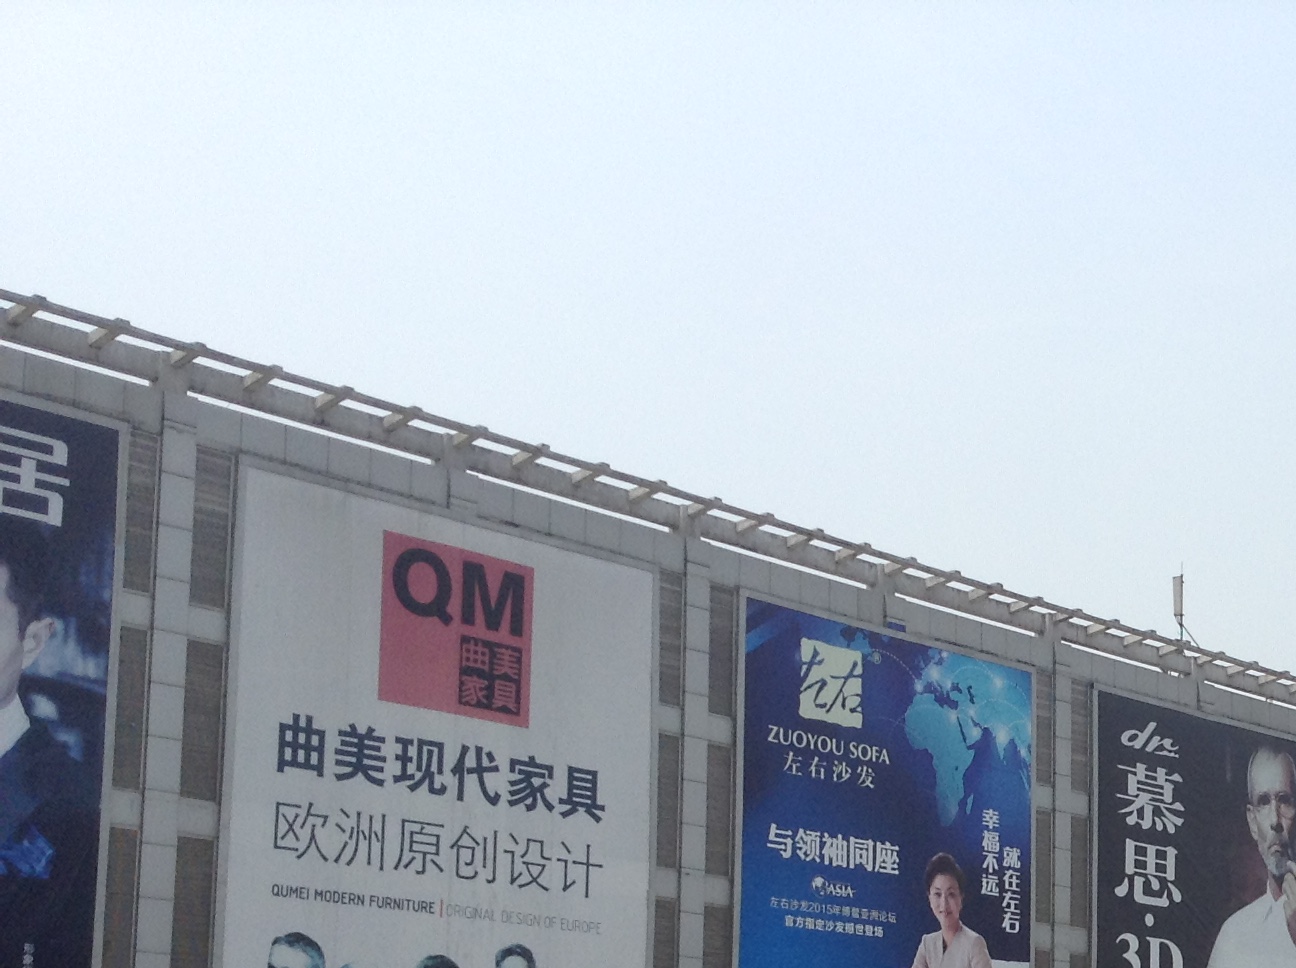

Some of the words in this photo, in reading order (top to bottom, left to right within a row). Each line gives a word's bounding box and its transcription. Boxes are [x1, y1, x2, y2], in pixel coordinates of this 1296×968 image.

[0, 425, 70, 528] 居
[393, 547, 525, 638] QM
[276, 712, 606, 823] 曲美现代家具
[768, 725, 844, 758] ZUOYOU
[849, 741, 891, 765] SOFA
[783, 752, 876, 789] 左右沙发
[272, 801, 604, 899] 欧洲原创设计
[766, 822, 900, 875] 与领袖同座
[981, 808, 1000, 897] 幸福不远
[1001, 846, 1022, 935] 就在左右
[271, 883, 310, 900] QUMEI
[314, 889, 365, 906] MODERN
[369, 895, 436, 915] FURNITURE
[446, 903, 496, 922] ORIGINAL
[501, 910, 541, 927] DESIGN
[544, 915, 557, 929] OF
[560, 918, 602, 935] EUROPE
